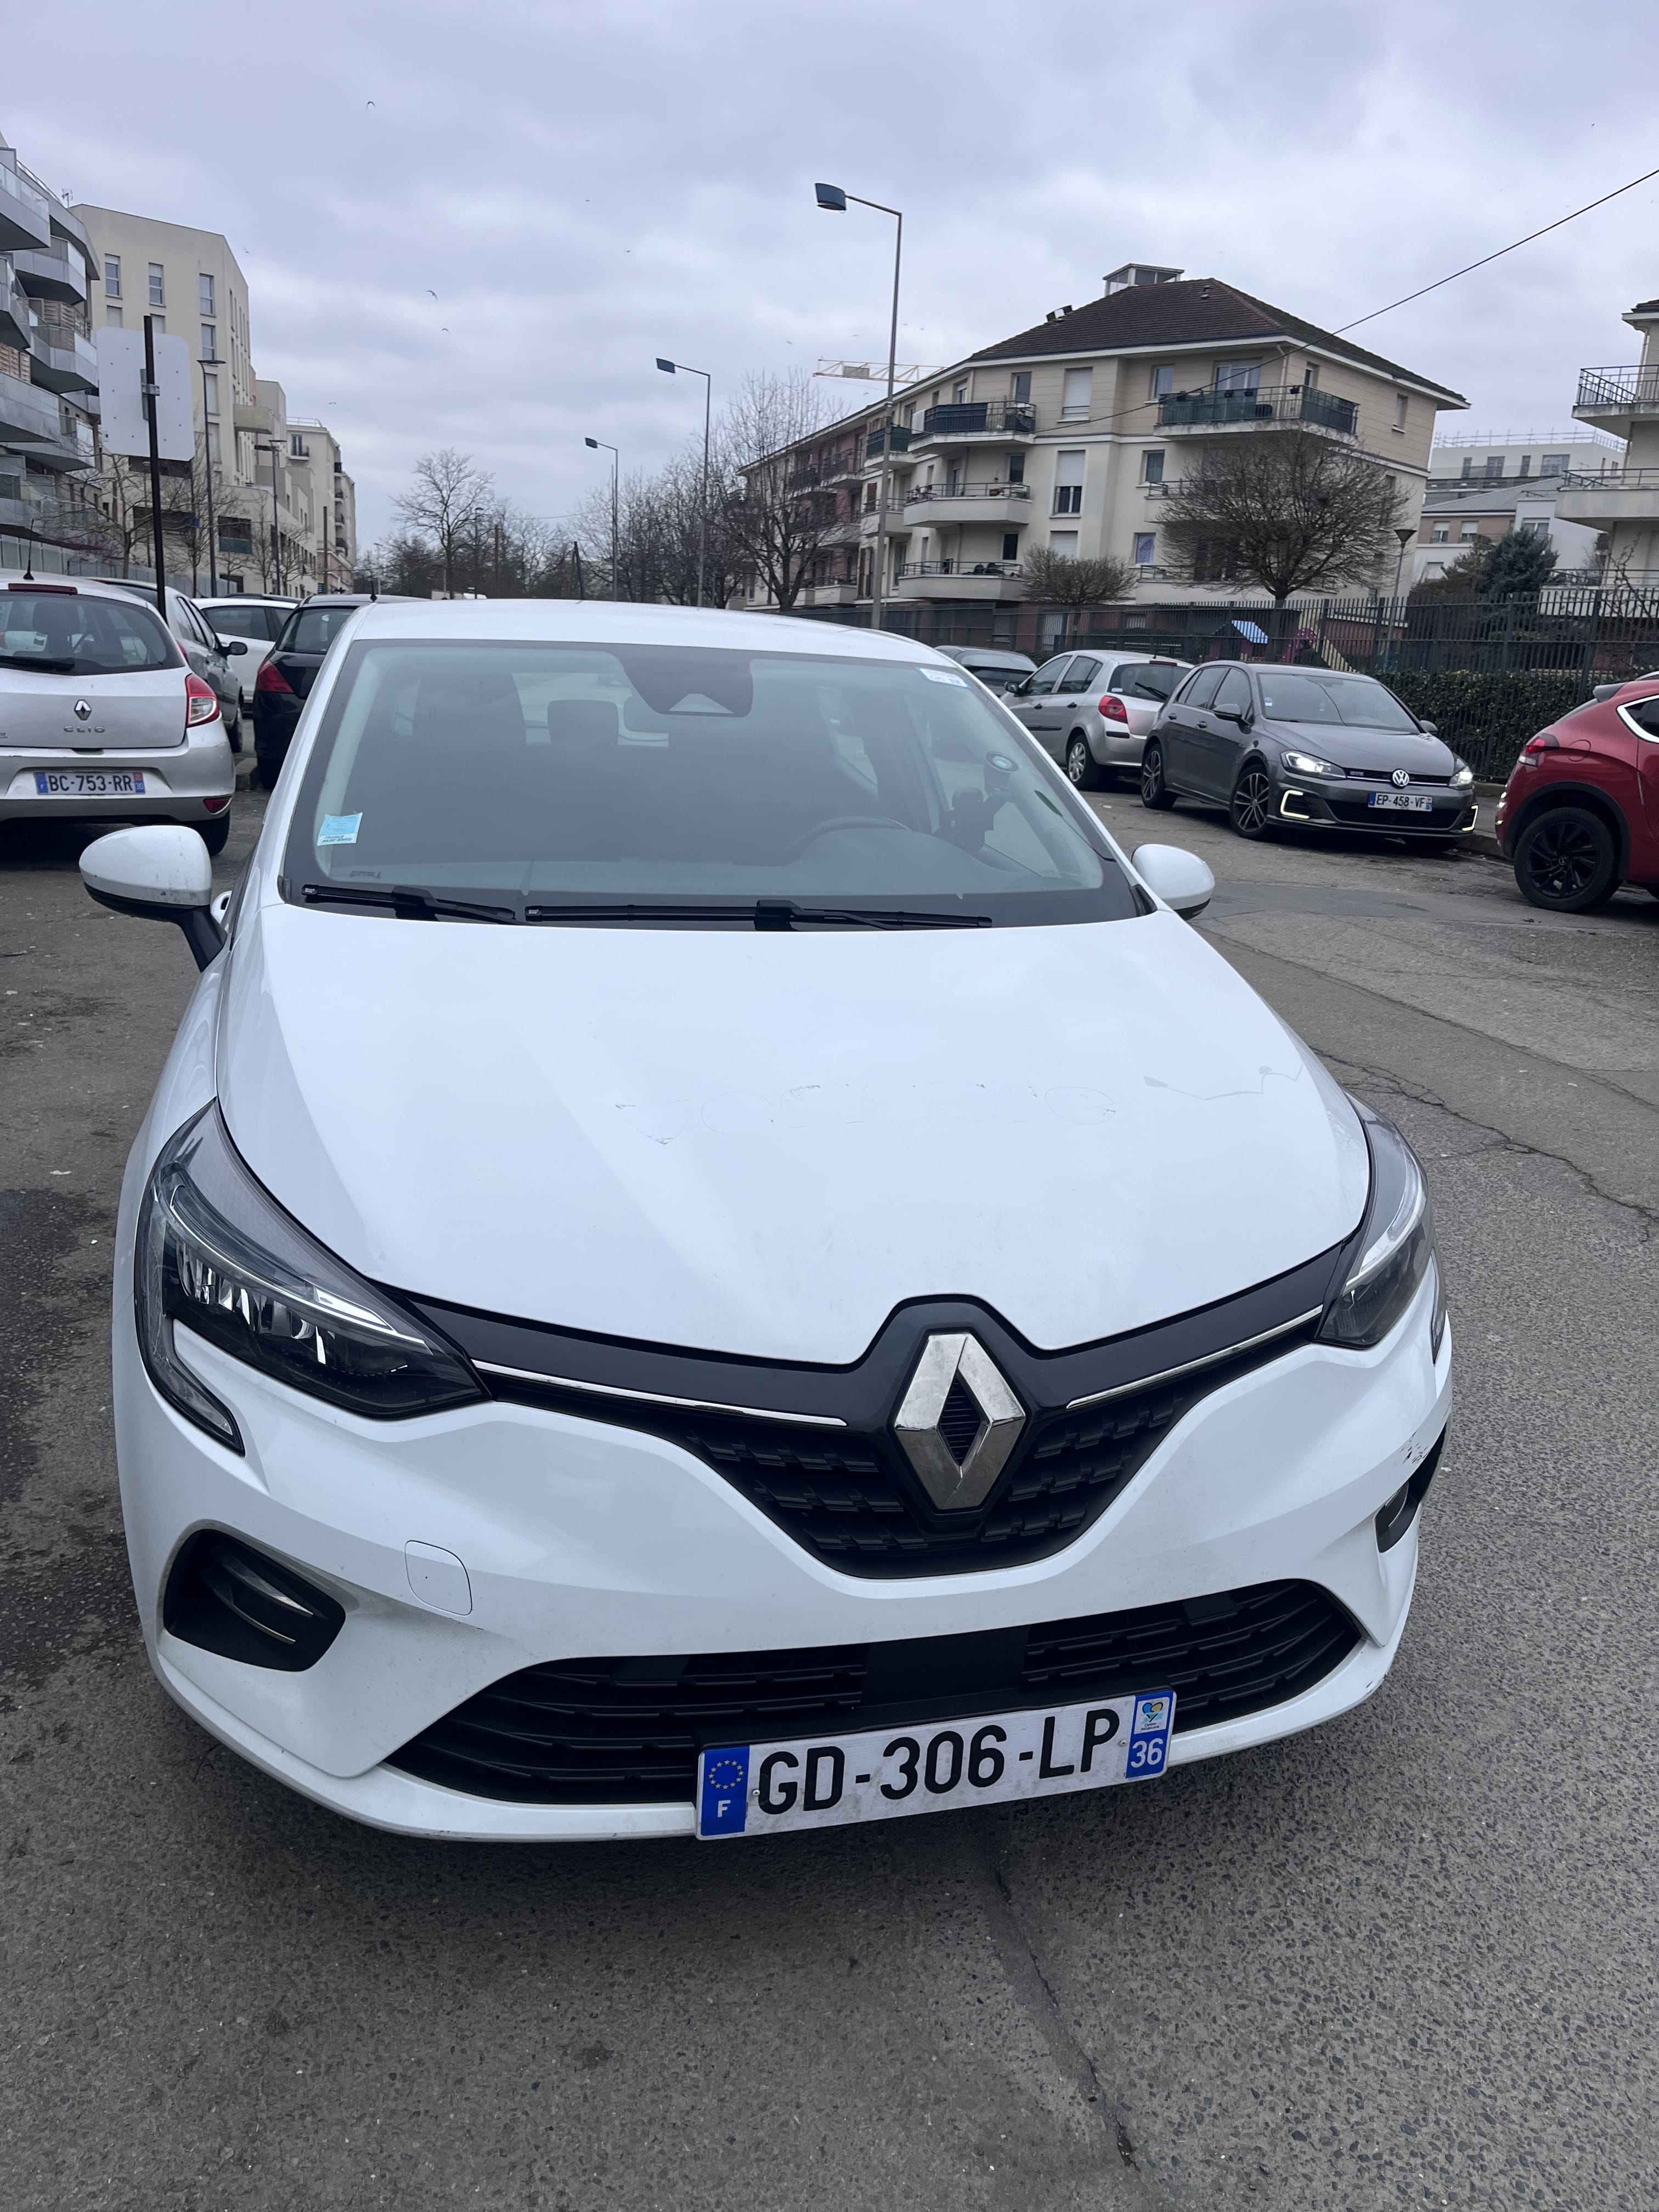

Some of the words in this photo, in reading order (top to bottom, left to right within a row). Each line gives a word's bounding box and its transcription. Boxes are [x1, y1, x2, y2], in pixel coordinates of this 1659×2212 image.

[63, 725, 105, 733] CLIO
[48, 775, 133, 792] BC-753-RR
[1376, 794, 1425, 808] EP-458-VF
[758, 1708, 1120, 1815] GD-306-LP
[1130, 1737, 1164, 1768] 36
[717, 1798, 731, 1818] F
